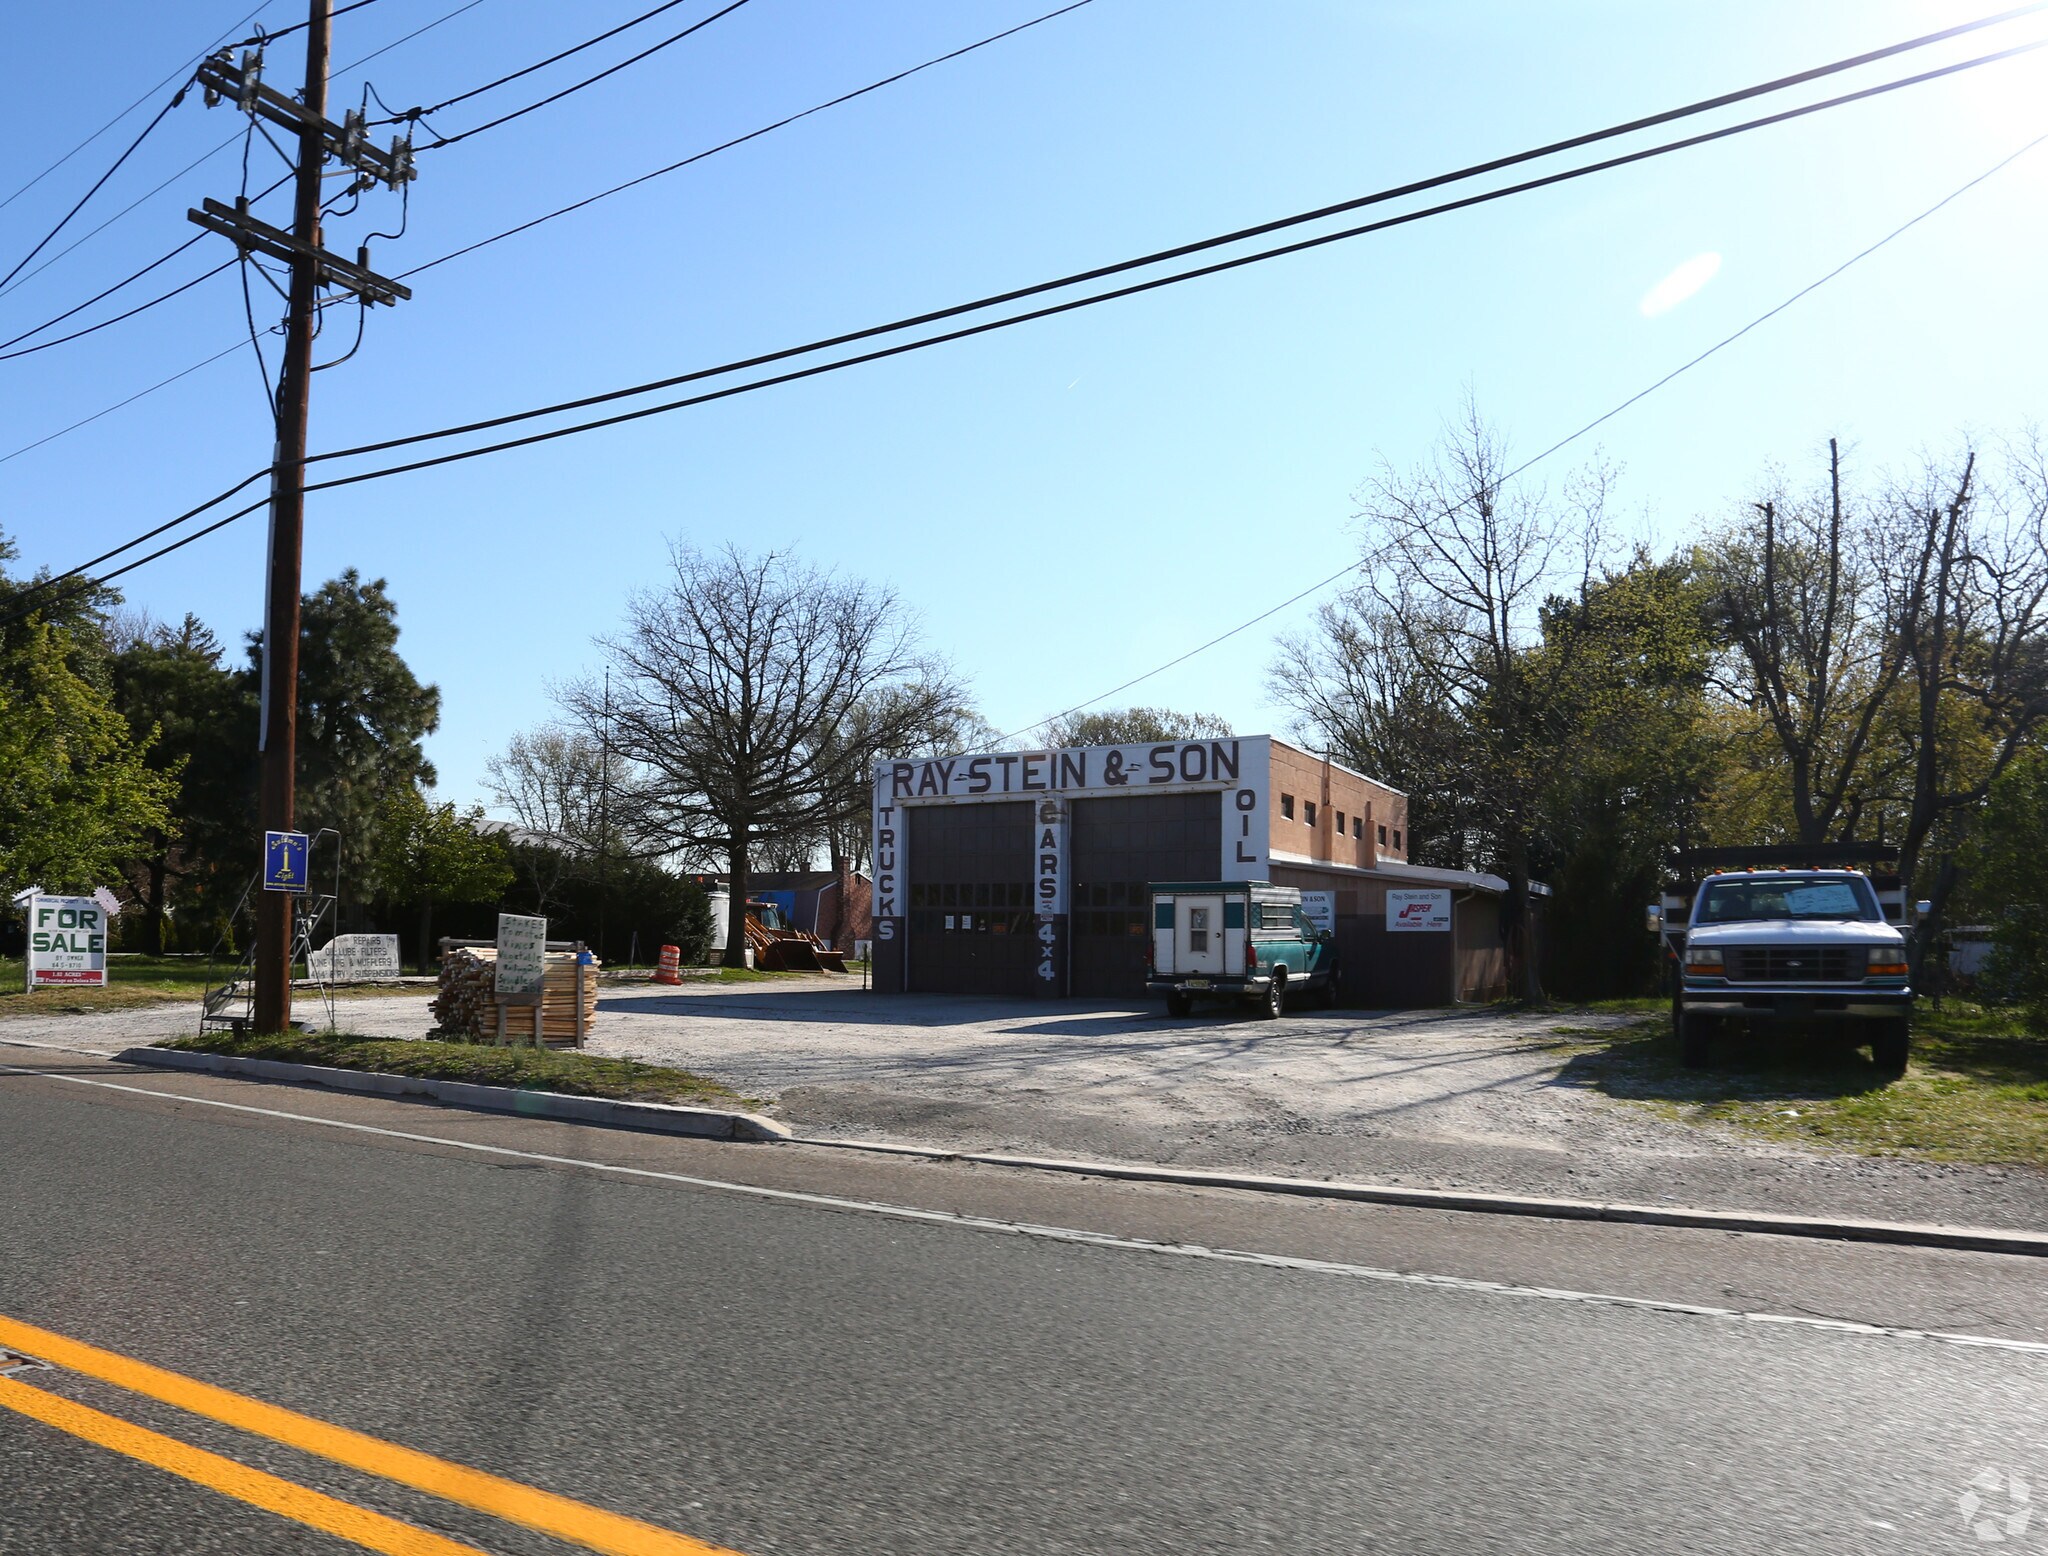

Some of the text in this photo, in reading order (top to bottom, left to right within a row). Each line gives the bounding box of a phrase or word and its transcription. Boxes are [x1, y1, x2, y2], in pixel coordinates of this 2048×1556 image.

[892, 740, 1239, 798] RAY STEIN & SON
[1235, 788, 1257, 863] OIL
[1038, 800, 1058, 899] CARS
[878, 806, 896, 941] TRUCKS
[1392, 893, 1403, 901] Ray
[1430, 892, 1442, 900] Son
[38, 908, 99, 930] FOR
[1399, 903, 1432, 918] JASPER
[32, 932, 104, 953] SALE
[353, 936, 381, 945] REPAIRS
